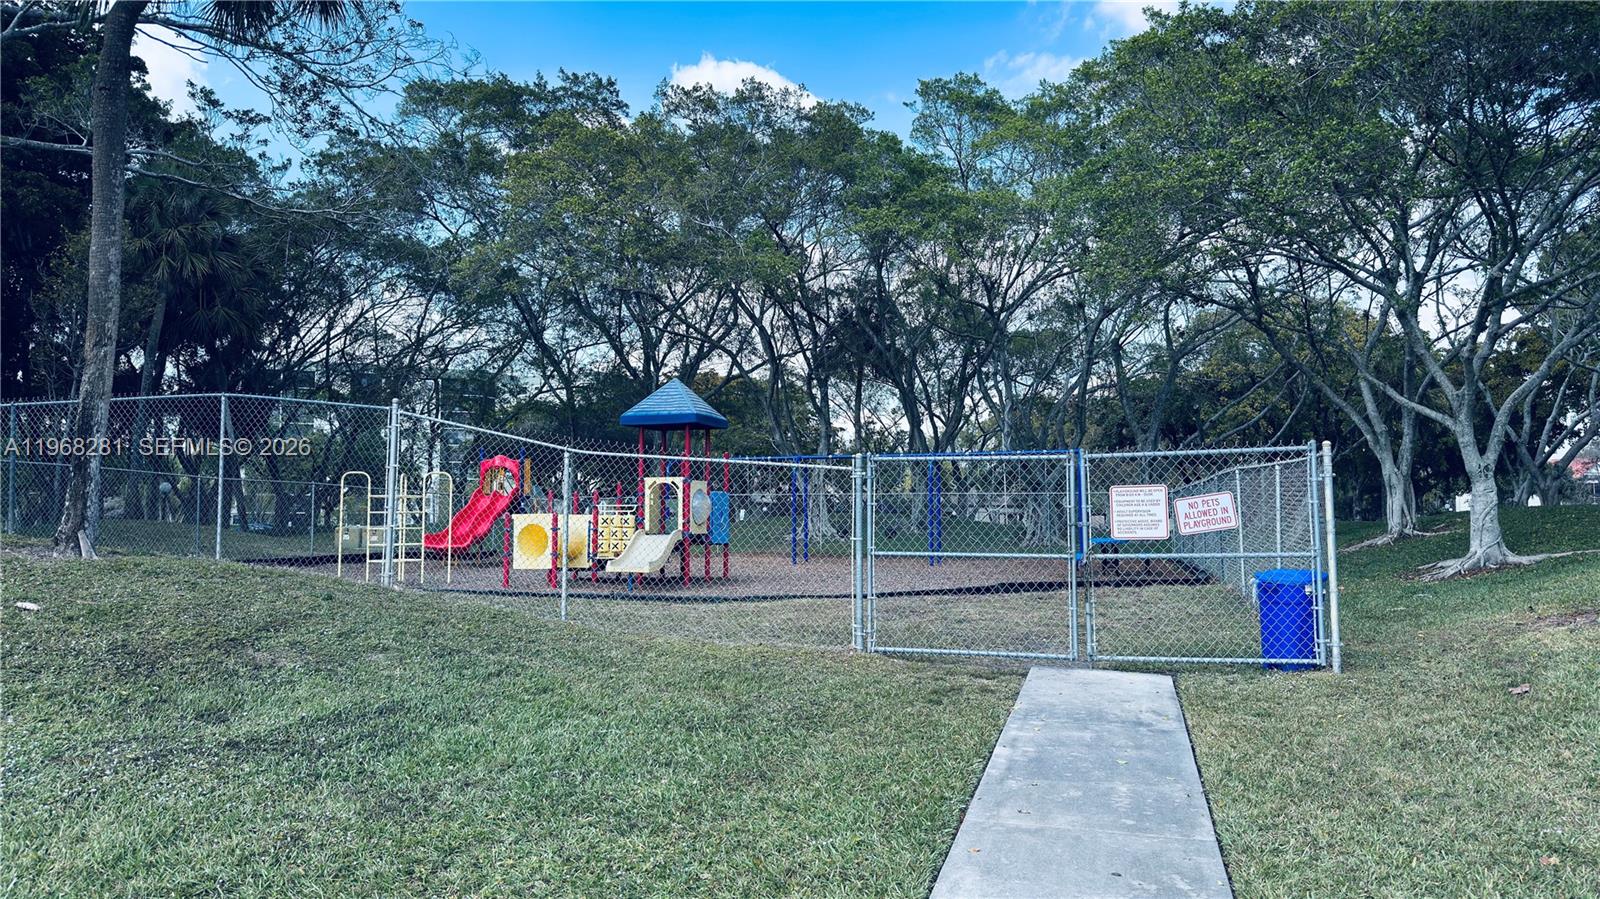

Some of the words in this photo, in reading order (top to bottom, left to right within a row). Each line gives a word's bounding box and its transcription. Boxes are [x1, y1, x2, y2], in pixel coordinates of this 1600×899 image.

[1188, 501, 1198, 510] NO
[1202, 498, 1220, 508] PETS
[1184, 508, 1217, 520] ALLOWED
[1184, 516, 1232, 529] PLAYGROUND
